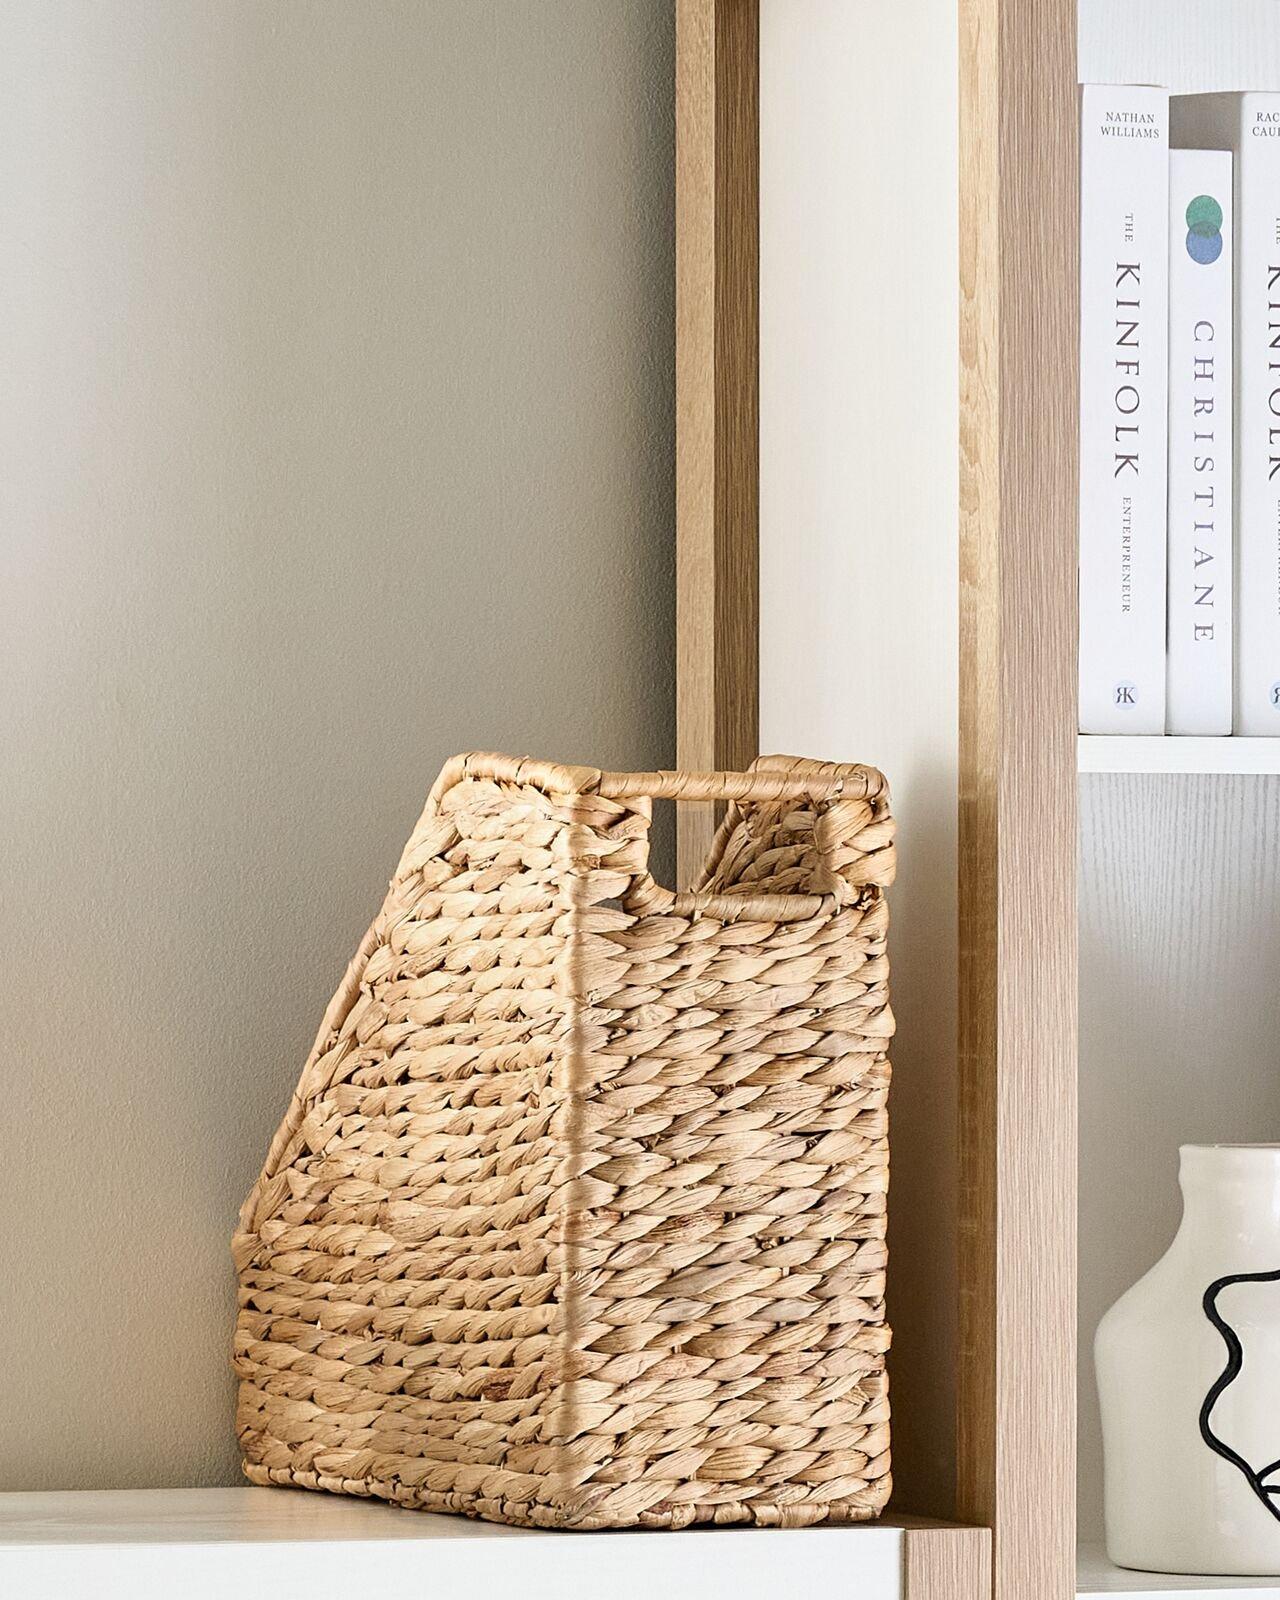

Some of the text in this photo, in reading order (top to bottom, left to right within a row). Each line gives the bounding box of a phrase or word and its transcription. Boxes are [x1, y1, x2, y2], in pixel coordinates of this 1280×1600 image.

[1100, 126, 1160, 139] WILLIAMS
[1105, 111, 1155, 125] NATHAN
[1115, 213, 1141, 613] THE KINFOLK ENTERPRENEUR
[1193, 320, 1215, 642] CHRISTIANE
